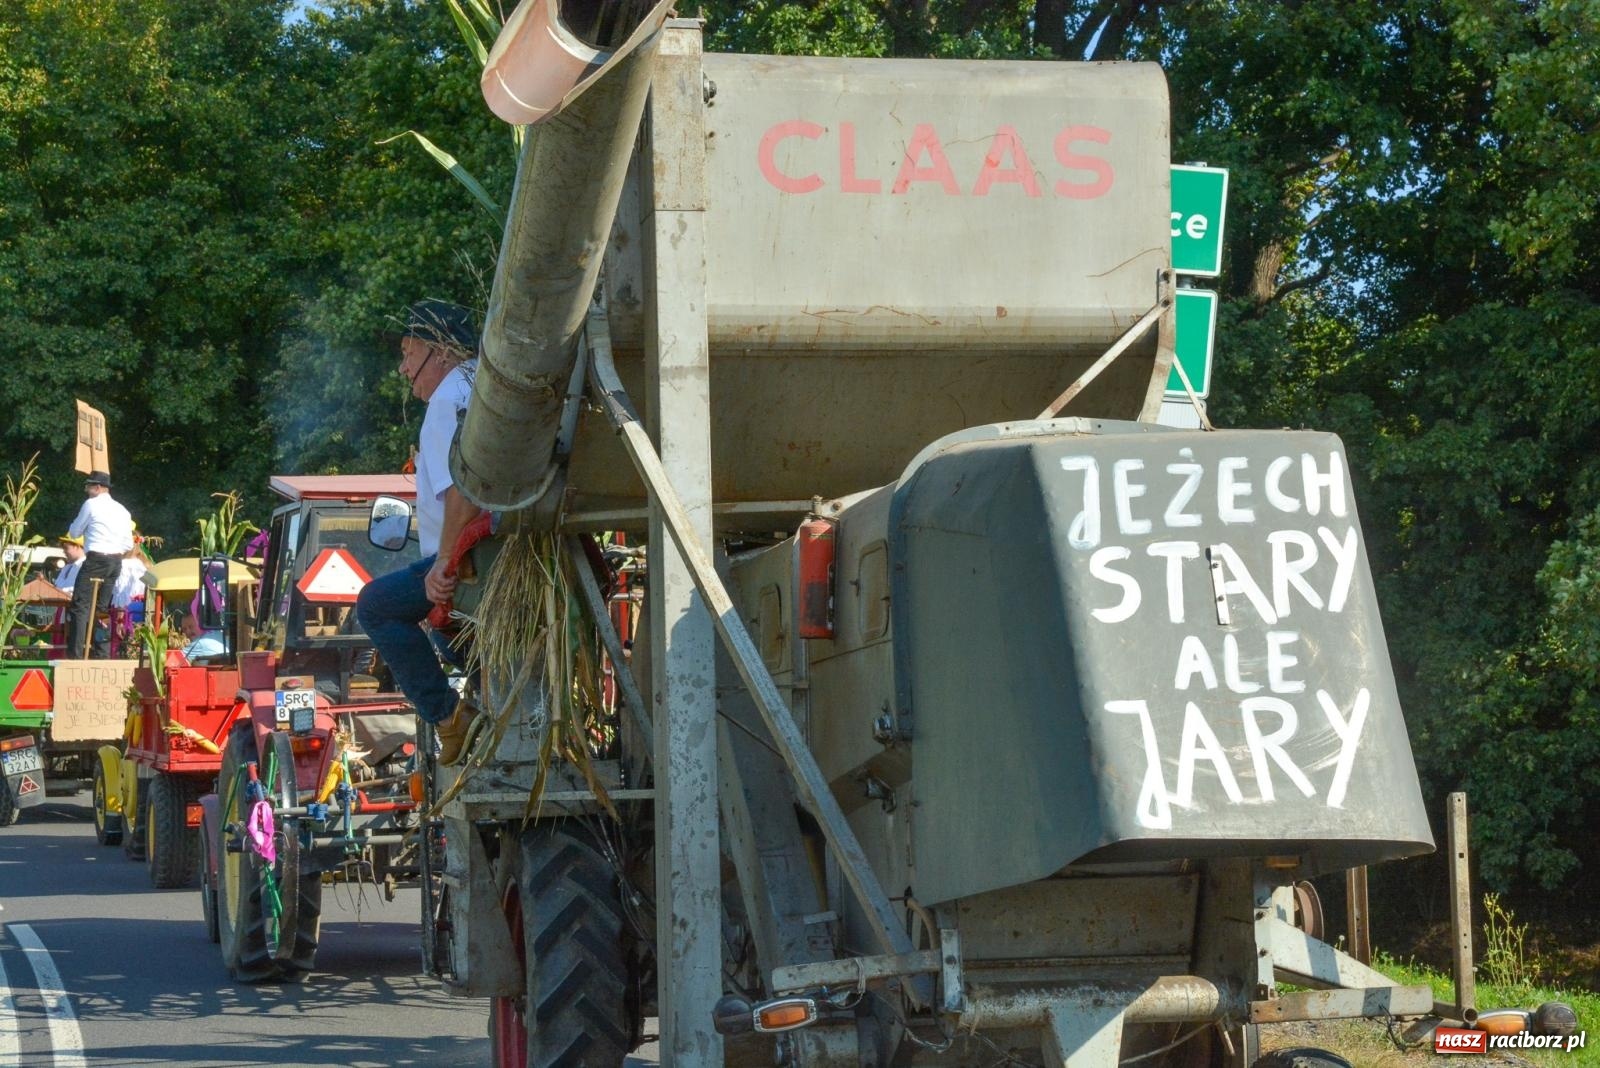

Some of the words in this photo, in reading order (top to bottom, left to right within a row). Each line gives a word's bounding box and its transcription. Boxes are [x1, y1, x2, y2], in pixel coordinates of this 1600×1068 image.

[757, 120, 1116, 199] CLAAS
[1060, 448, 1347, 550] JEŻECH
[1089, 526, 1359, 626] STARY
[64, 667, 117, 685] TUTAJ
[1174, 631, 1306, 694] ALE
[67, 686, 109, 701] FRELE
[285, 693, 309, 704] SRC
[8, 757, 36, 773] 32AY
[9, 748, 32, 761] SRC
[1104, 688, 1371, 830] JARY
